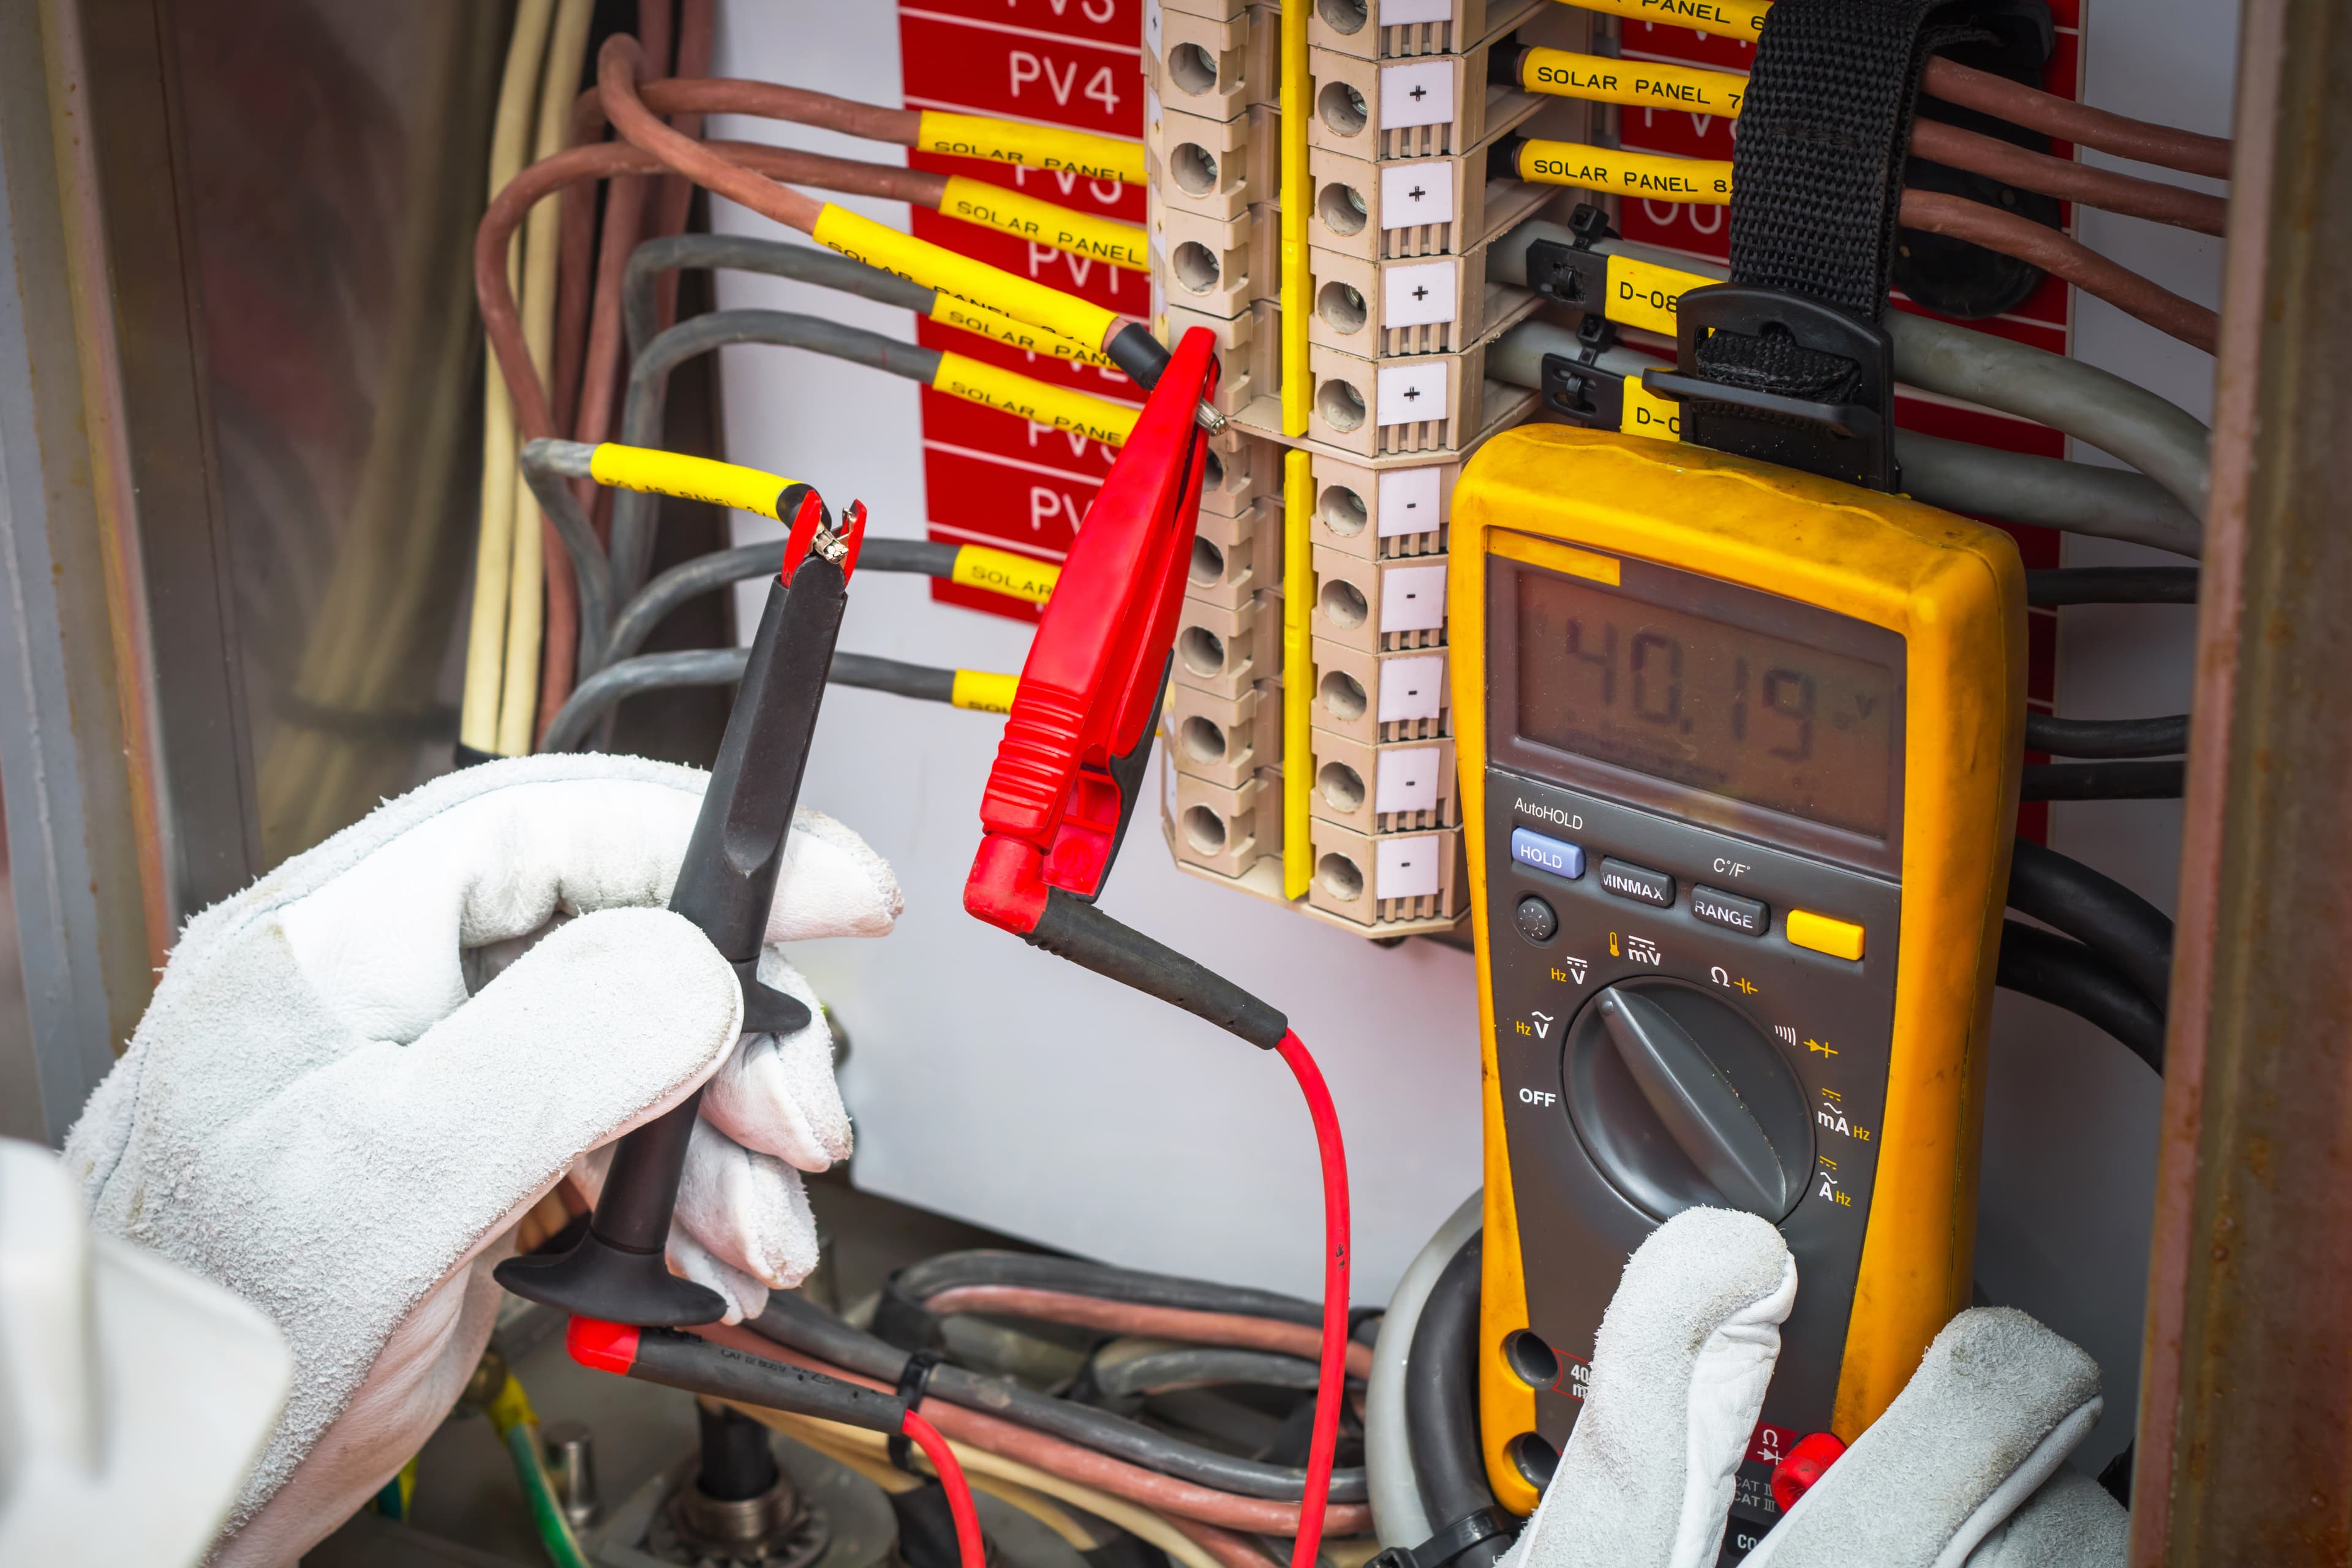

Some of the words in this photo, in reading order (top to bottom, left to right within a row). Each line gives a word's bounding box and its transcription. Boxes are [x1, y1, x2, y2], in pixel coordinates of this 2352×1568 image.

[1009, 50, 1120, 115] PV4
[1537, 67, 1617, 91] SOLAR
[1635, 80, 1711, 104] PANEL
[1727, 94, 1741, 109] 7
[935, 141, 1024, 164] SOLAR
[1044, 158, 1136, 183] PANEL
[1534, 160, 1608, 183] SOLAR
[1624, 172, 1698, 192] PANEL
[957, 202, 1039, 235] SOLAR
[1058, 232, 1142, 265] PANEL
[949, 311, 1035, 349] SOLAR
[1055, 345, 1115, 366] PAN
[951, 381, 1035, 417] SOLAR
[1055, 417, 1122, 442] PANE
[1565, 616, 1817, 763] 40.19
[1514, 797, 1583, 830] AutoHOLD
[1520, 844, 1562, 869] HOLD
[1694, 900, 1754, 929] RANGE
[1551, 968, 1566, 982] Hz
[1516, 1021, 1531, 1036] Hz
[1518, 1088, 1556, 1107] OFF
[1817, 1110, 1850, 1136] mA
[1853, 1126, 1871, 1142] Hz
[1836, 1192, 1852, 1207] Hz
[1570, 1364, 1589, 1383] 40
[1735, 1476, 1760, 1492] CAT
[1735, 1491, 1761, 1507] CAT
[1737, 1534, 1758, 1551] CO
